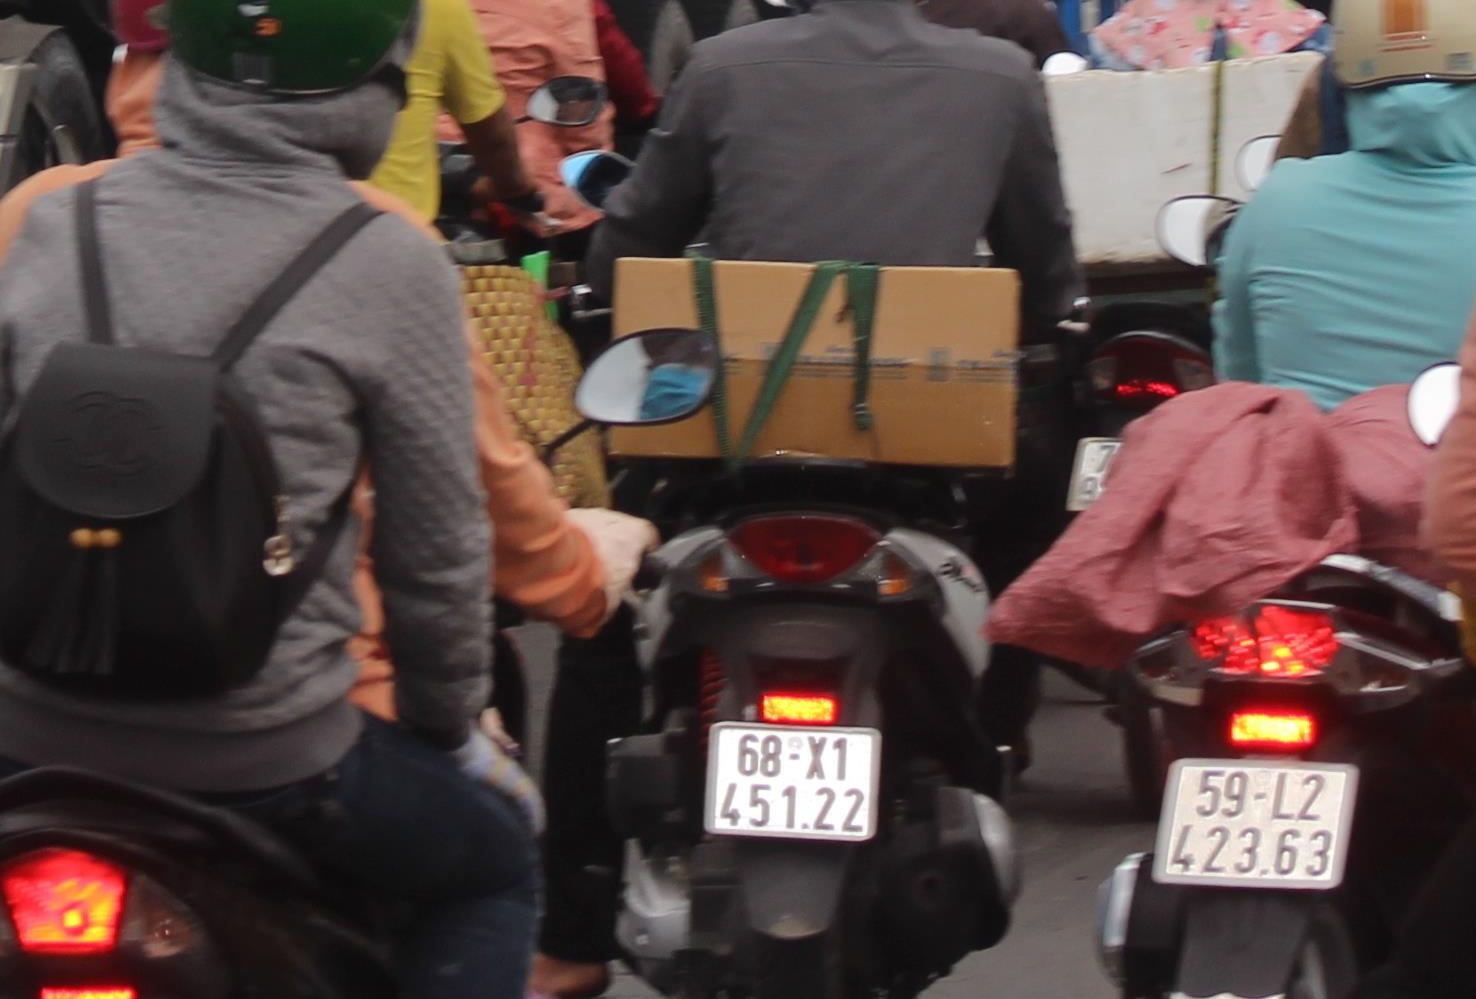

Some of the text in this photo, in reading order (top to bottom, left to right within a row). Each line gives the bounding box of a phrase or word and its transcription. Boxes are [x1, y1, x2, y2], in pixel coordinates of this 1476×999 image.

[737, 734, 848, 781] 68-X1
[720, 783, 865, 832] 451.22
[1196, 770, 1326, 820] 59-L2
[1171, 824, 1333, 877] 423.63
